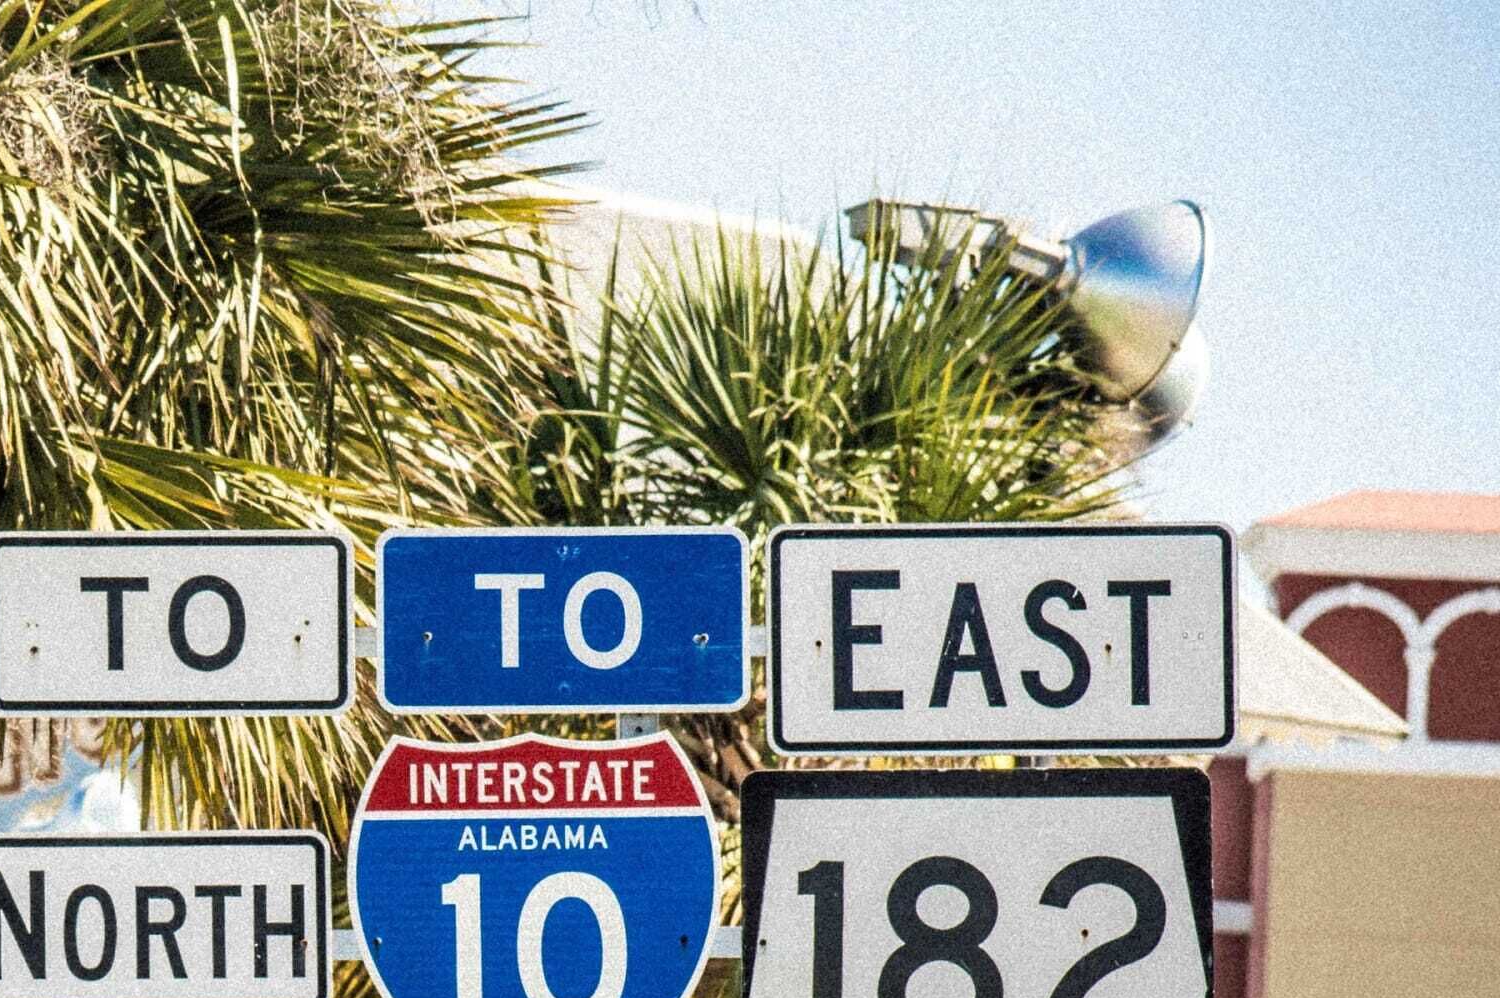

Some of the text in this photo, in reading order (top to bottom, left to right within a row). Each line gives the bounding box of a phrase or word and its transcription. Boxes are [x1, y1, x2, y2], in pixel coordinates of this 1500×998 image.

[80, 575, 246, 672] TO
[475, 571, 642, 669] TO
[832, 569, 1171, 710] EAST
[409, 760, 656, 804] INTERSTATE
[458, 824, 609, 851] ALABAMA
